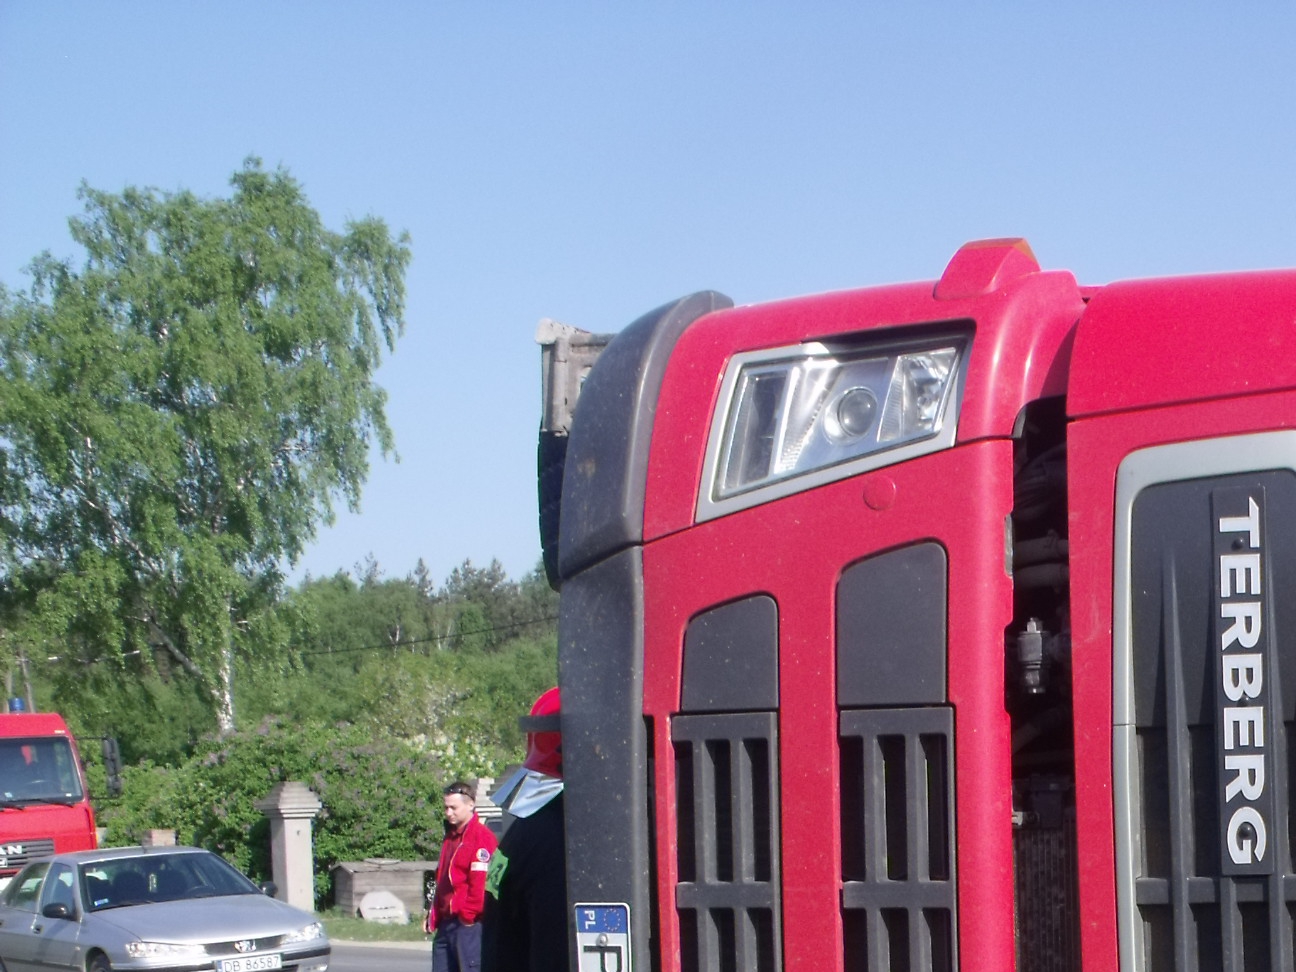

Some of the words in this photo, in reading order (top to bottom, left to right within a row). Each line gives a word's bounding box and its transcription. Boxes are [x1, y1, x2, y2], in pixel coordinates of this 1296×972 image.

[1218, 496, 1267, 865] TERBERG
[584, 910, 596, 929] PL
[224, 961, 241, 972] DB
[246, 955, 279, 970] 86587
